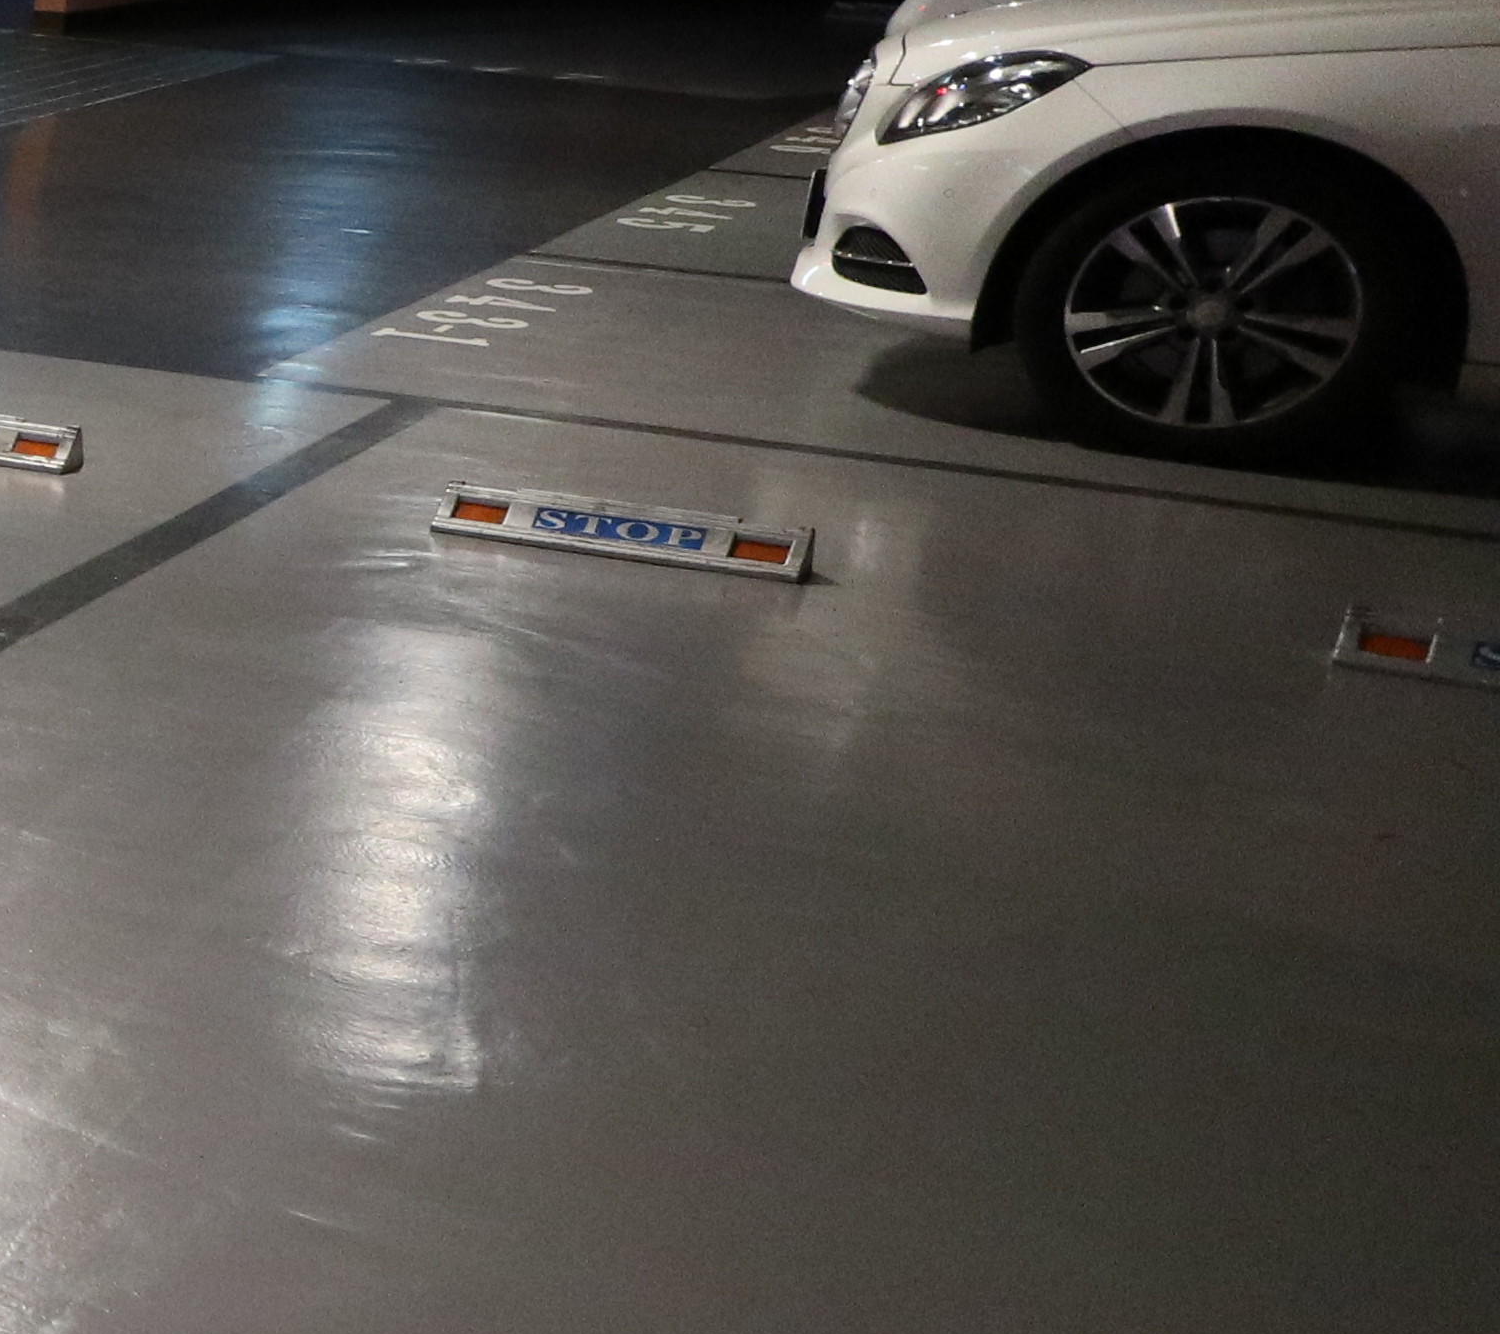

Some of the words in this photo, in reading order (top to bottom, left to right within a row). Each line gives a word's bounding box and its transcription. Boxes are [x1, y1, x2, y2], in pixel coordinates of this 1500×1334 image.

[616, 194, 757, 234] 345
[370, 277, 593, 347] 343-1
[534, 509, 702, 546] STOP
